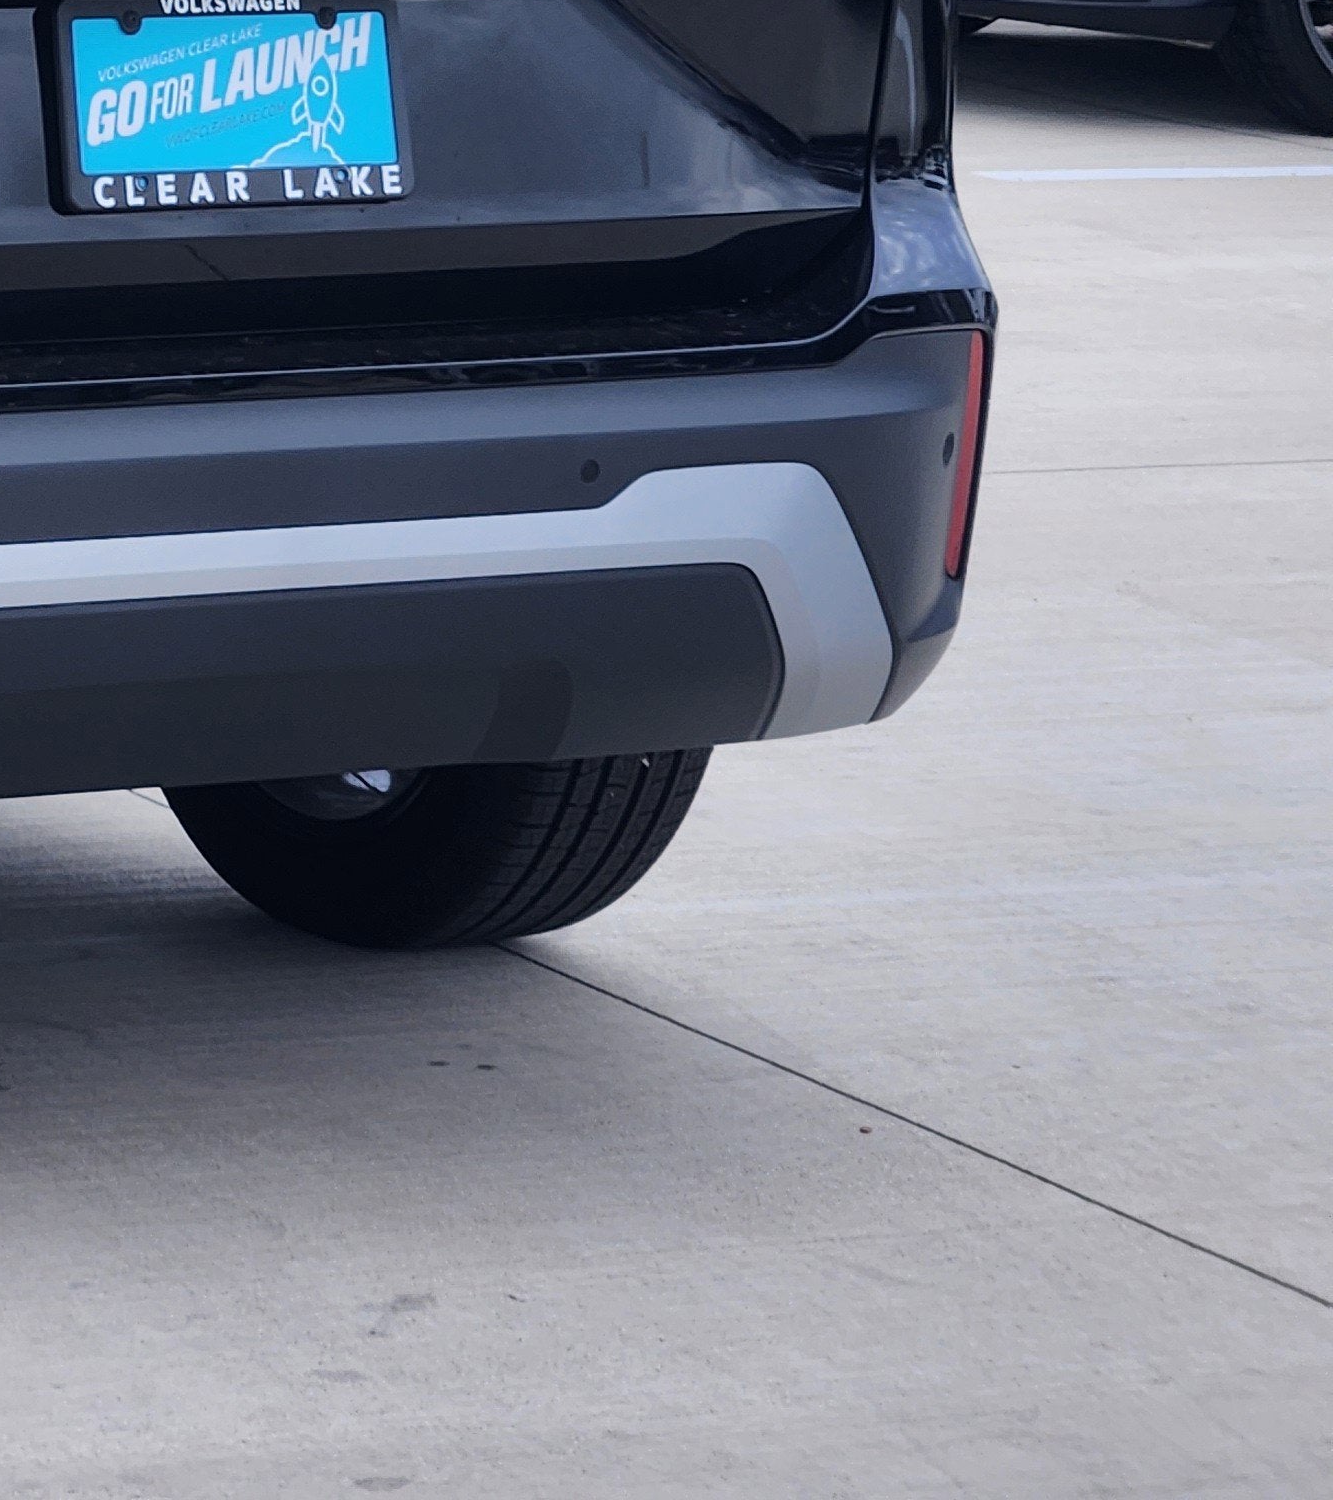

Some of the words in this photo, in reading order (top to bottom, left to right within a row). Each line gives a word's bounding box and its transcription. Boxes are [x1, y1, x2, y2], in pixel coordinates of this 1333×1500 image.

[86, 80, 148, 147] GO
[149, 73, 194, 125] FOR
[199, 11, 371, 114] LAUNCH
[98, 46, 185, 82] VOLKSWAGEN
[187, 33, 228, 57] CLEAR
[231, 23, 263, 45] LAKE
[93, 172, 251, 209] CLEAR
[284, 164, 403, 199] LAKE
